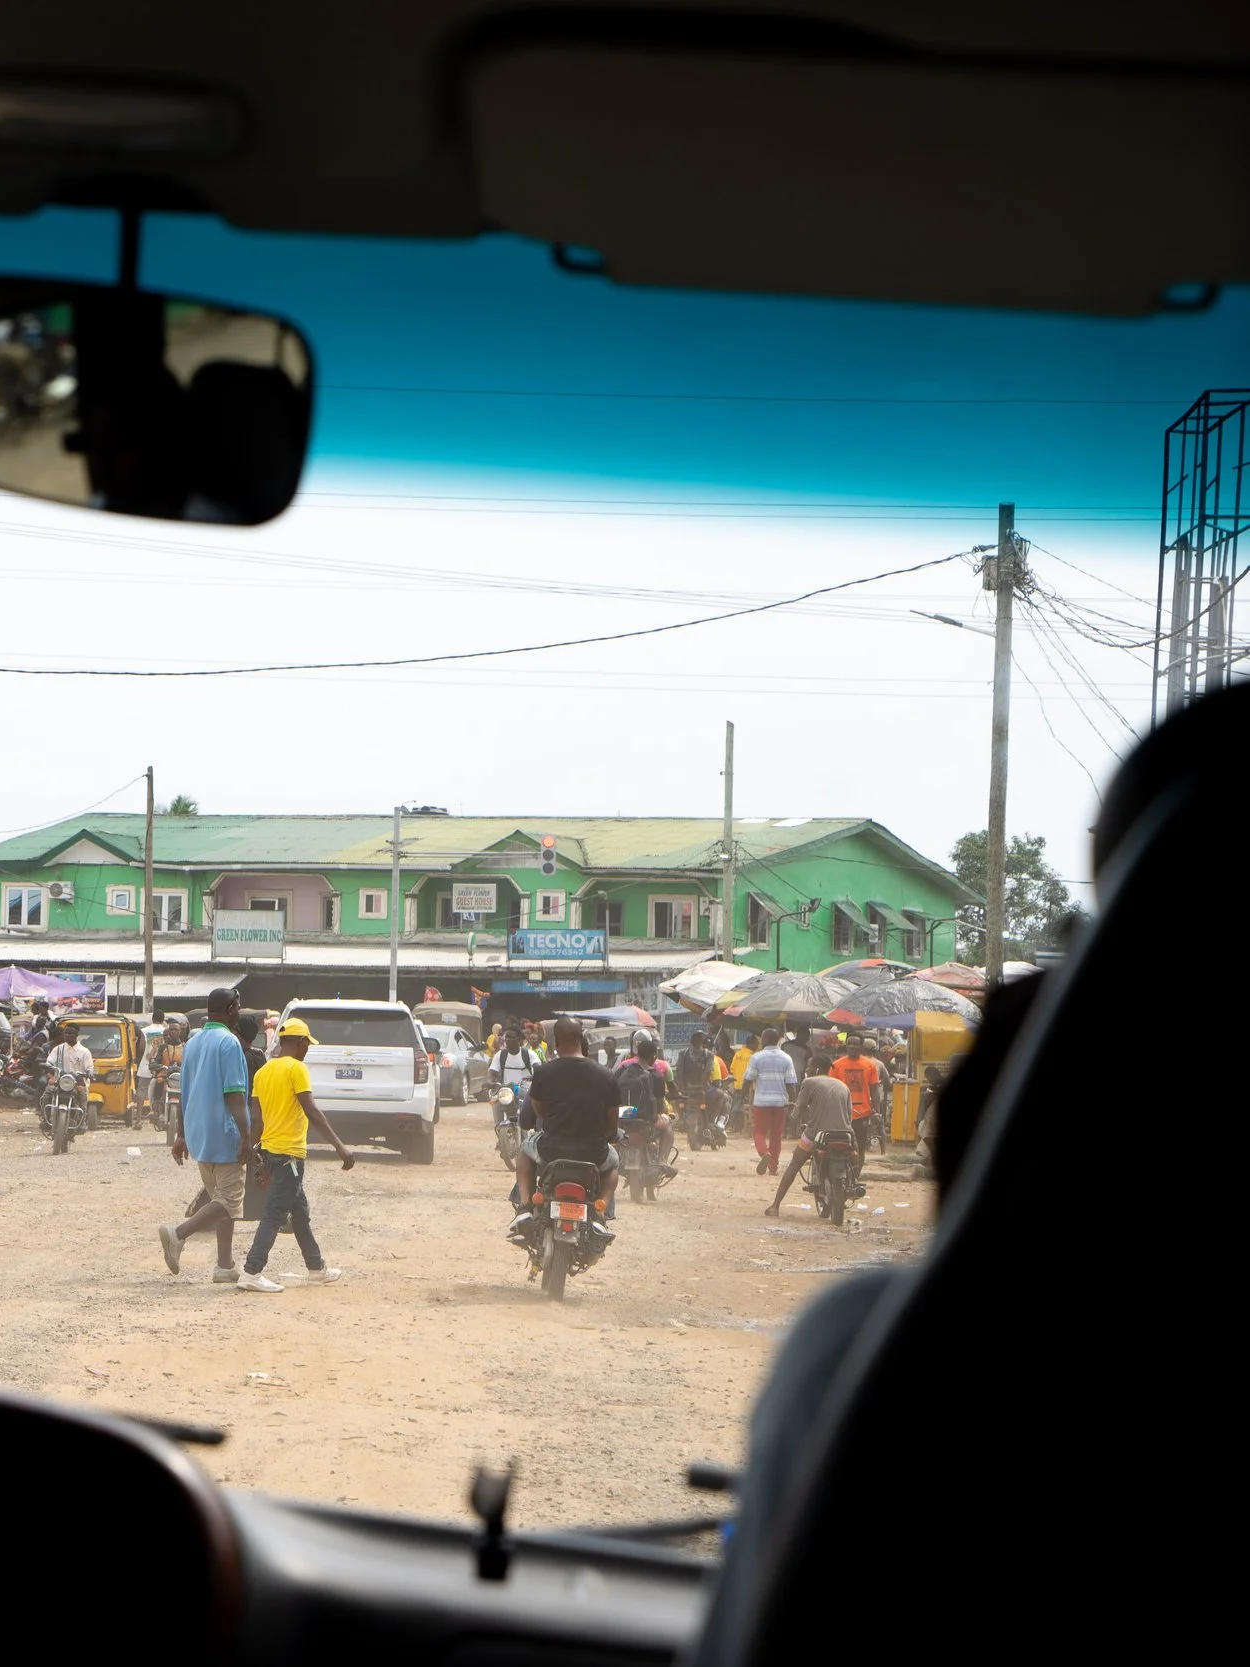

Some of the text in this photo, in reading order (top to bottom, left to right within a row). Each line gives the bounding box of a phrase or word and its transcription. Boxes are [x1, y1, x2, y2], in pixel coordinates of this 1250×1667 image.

[456, 897, 493, 906] GUEST HOUSE
[216, 928, 240, 941] GREEN
[240, 928, 268, 942] FLOWER
[526, 933, 586, 948] TECNO
